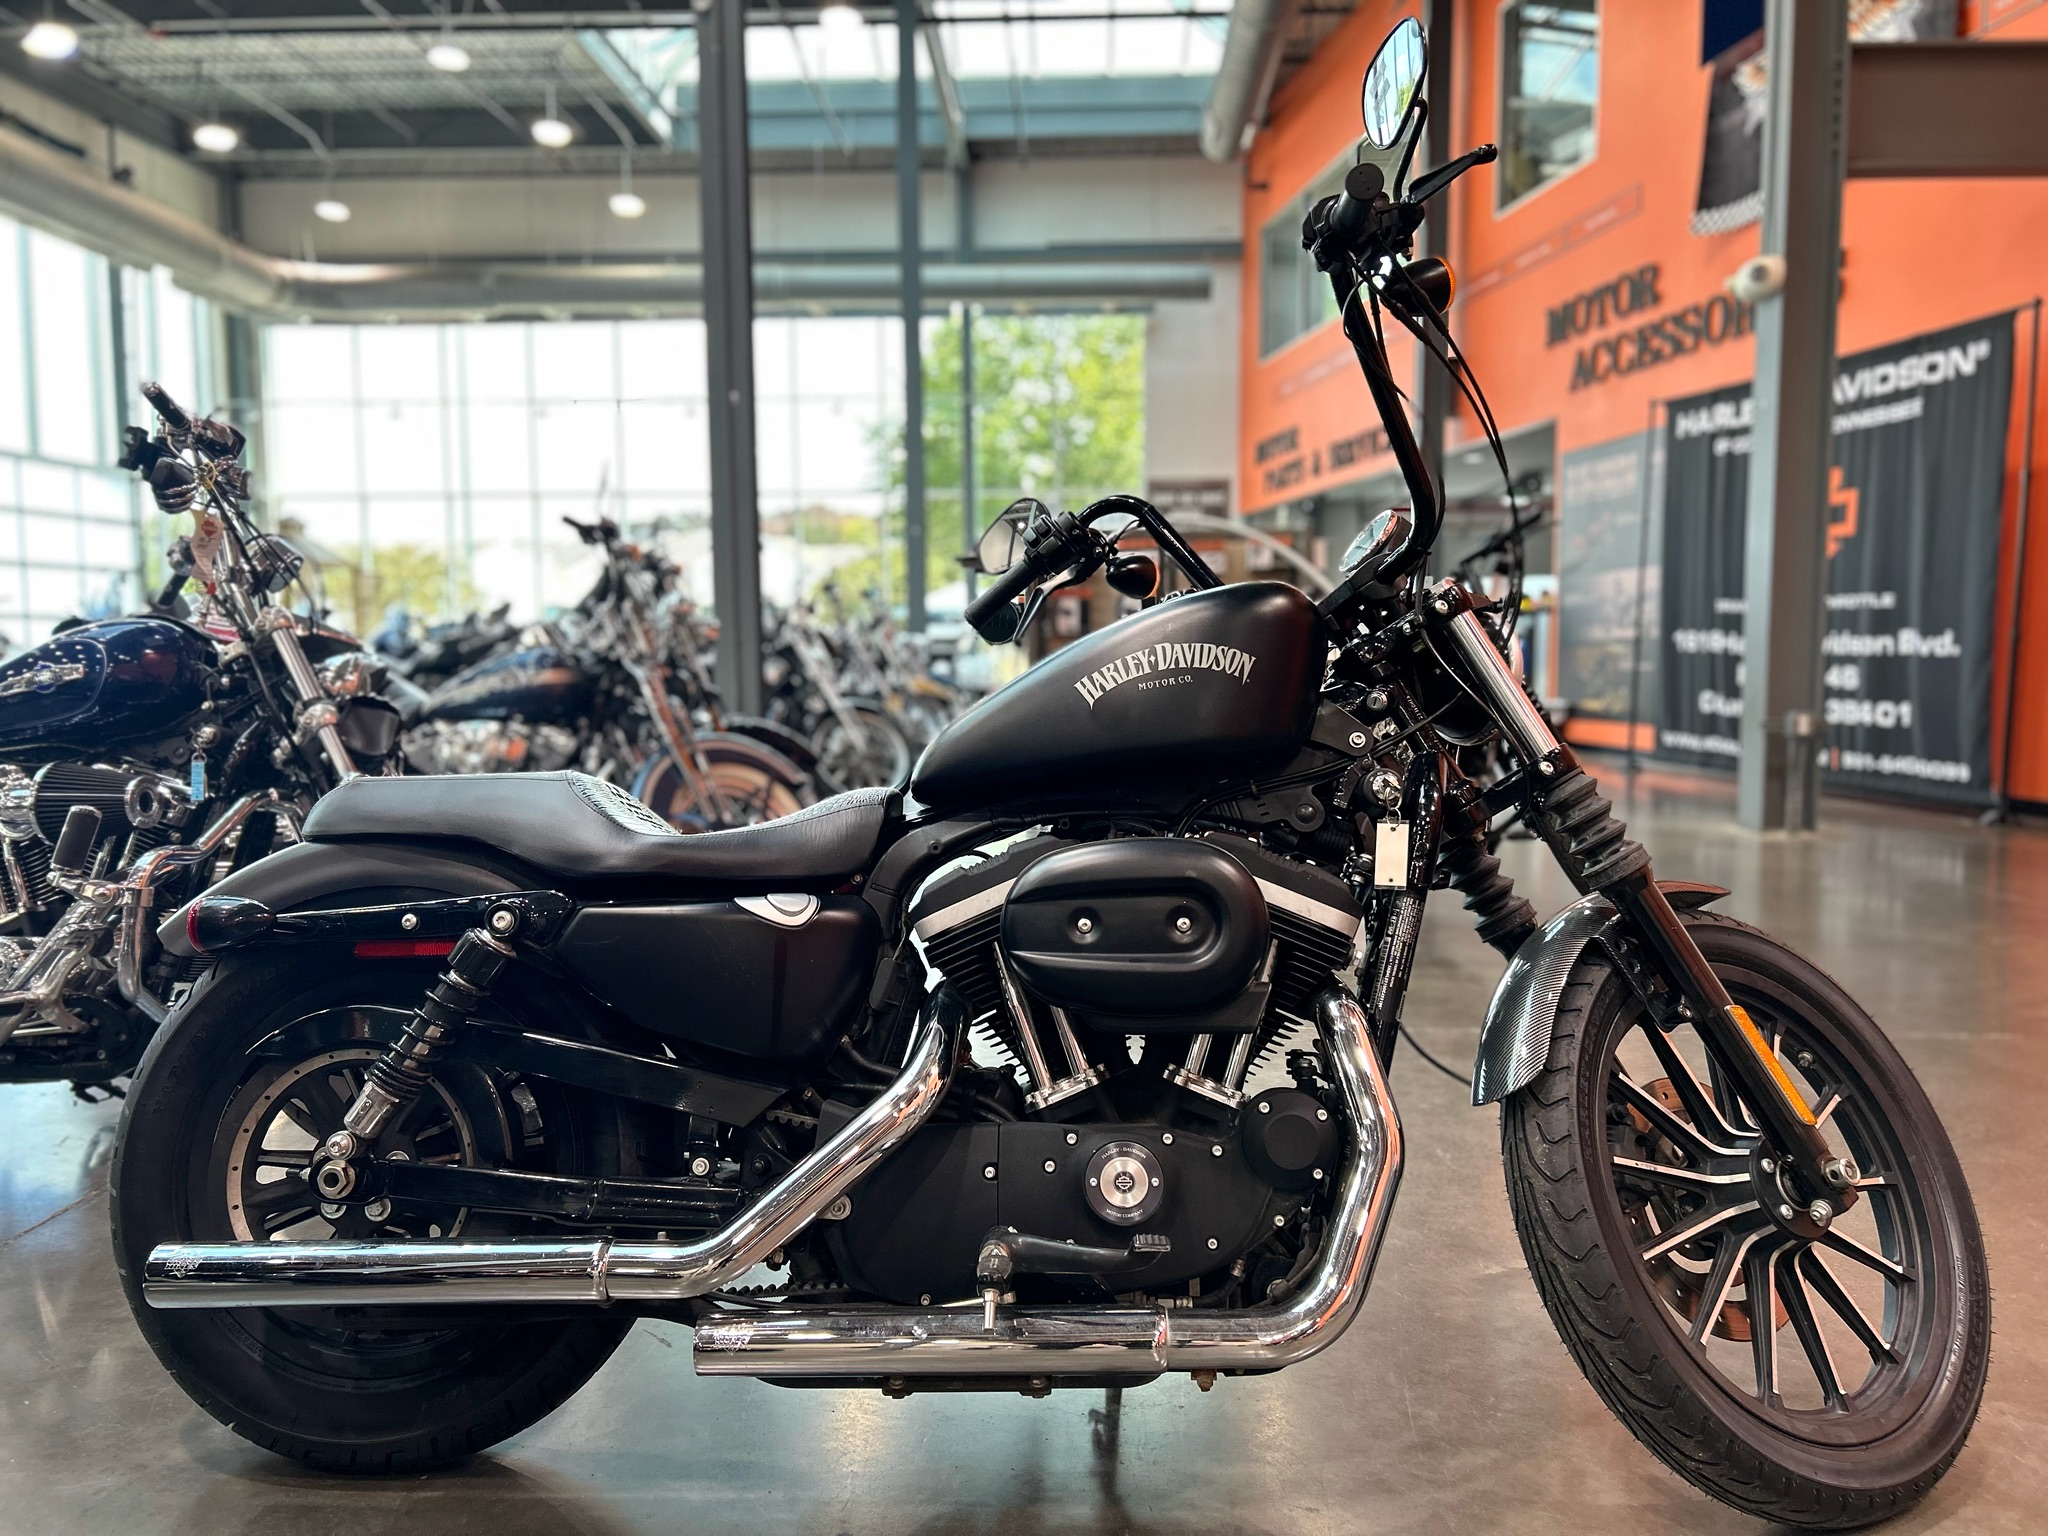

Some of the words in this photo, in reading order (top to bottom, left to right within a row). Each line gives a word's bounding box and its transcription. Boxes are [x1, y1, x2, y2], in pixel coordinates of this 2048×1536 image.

[1546, 262, 1660, 348] MOTOR
[1569, 294, 1755, 393] ACCESSOR
[1138, 677, 1176, 690] MOTOR
[1178, 674, 1193, 684] CO.
[1106, 1208, 1122, 1218] MOTOR
[1123, 1209, 1144, 1218] COMPANY
